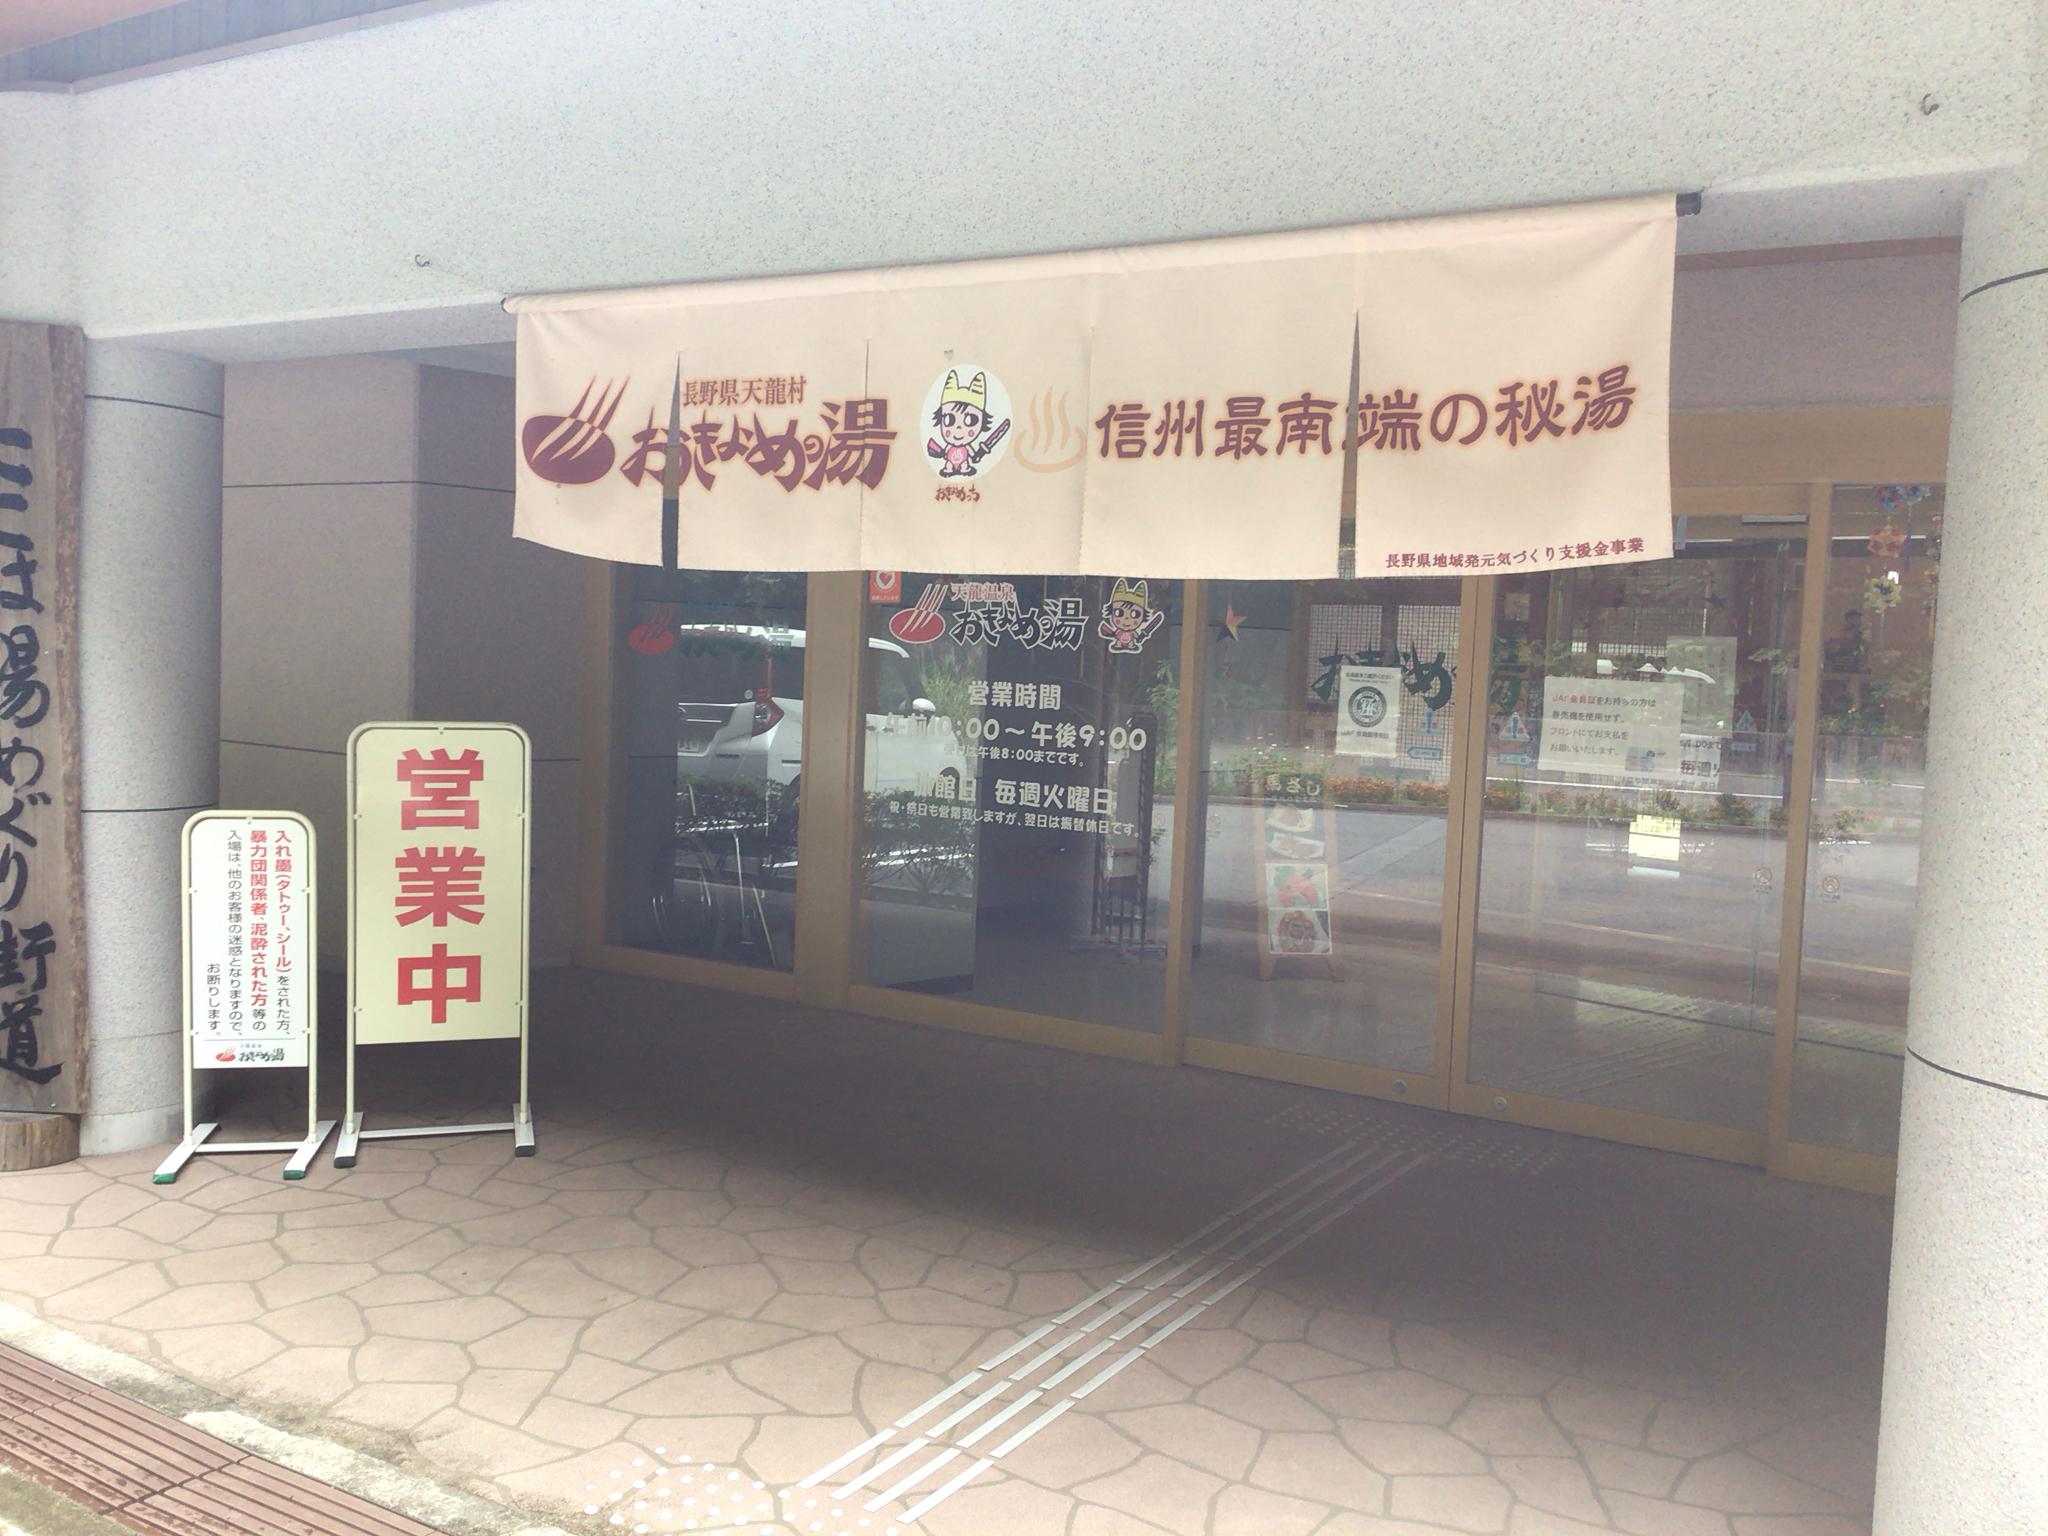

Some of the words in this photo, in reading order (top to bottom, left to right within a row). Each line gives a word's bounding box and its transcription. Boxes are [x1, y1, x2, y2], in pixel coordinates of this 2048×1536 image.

[682, 375, 808, 408] 長野県天龍村
[1094, 364, 1637, 461] 信州最南端の秘湯
[620, 397, 898, 492] おきよめの湯
[1385, 536, 1645, 569] 長野県地域発元気づくり支援金事業
[950, 582, 1015, 602] 天龍温泉
[948, 597, 1089, 652] おきよめの湯
[967, 681, 1062, 711] 営業時間
[995, 778, 1114, 815] 毎週火曜日
[394, 747, 485, 1025] 営業中
[227, 829, 243, 1037] 入場は、他のお客様の迷惑となりますので、
[250, 829, 268, 1032] 暴力団関係者、泥酔された方等の
[206, 962, 221, 1036] お断りします。
